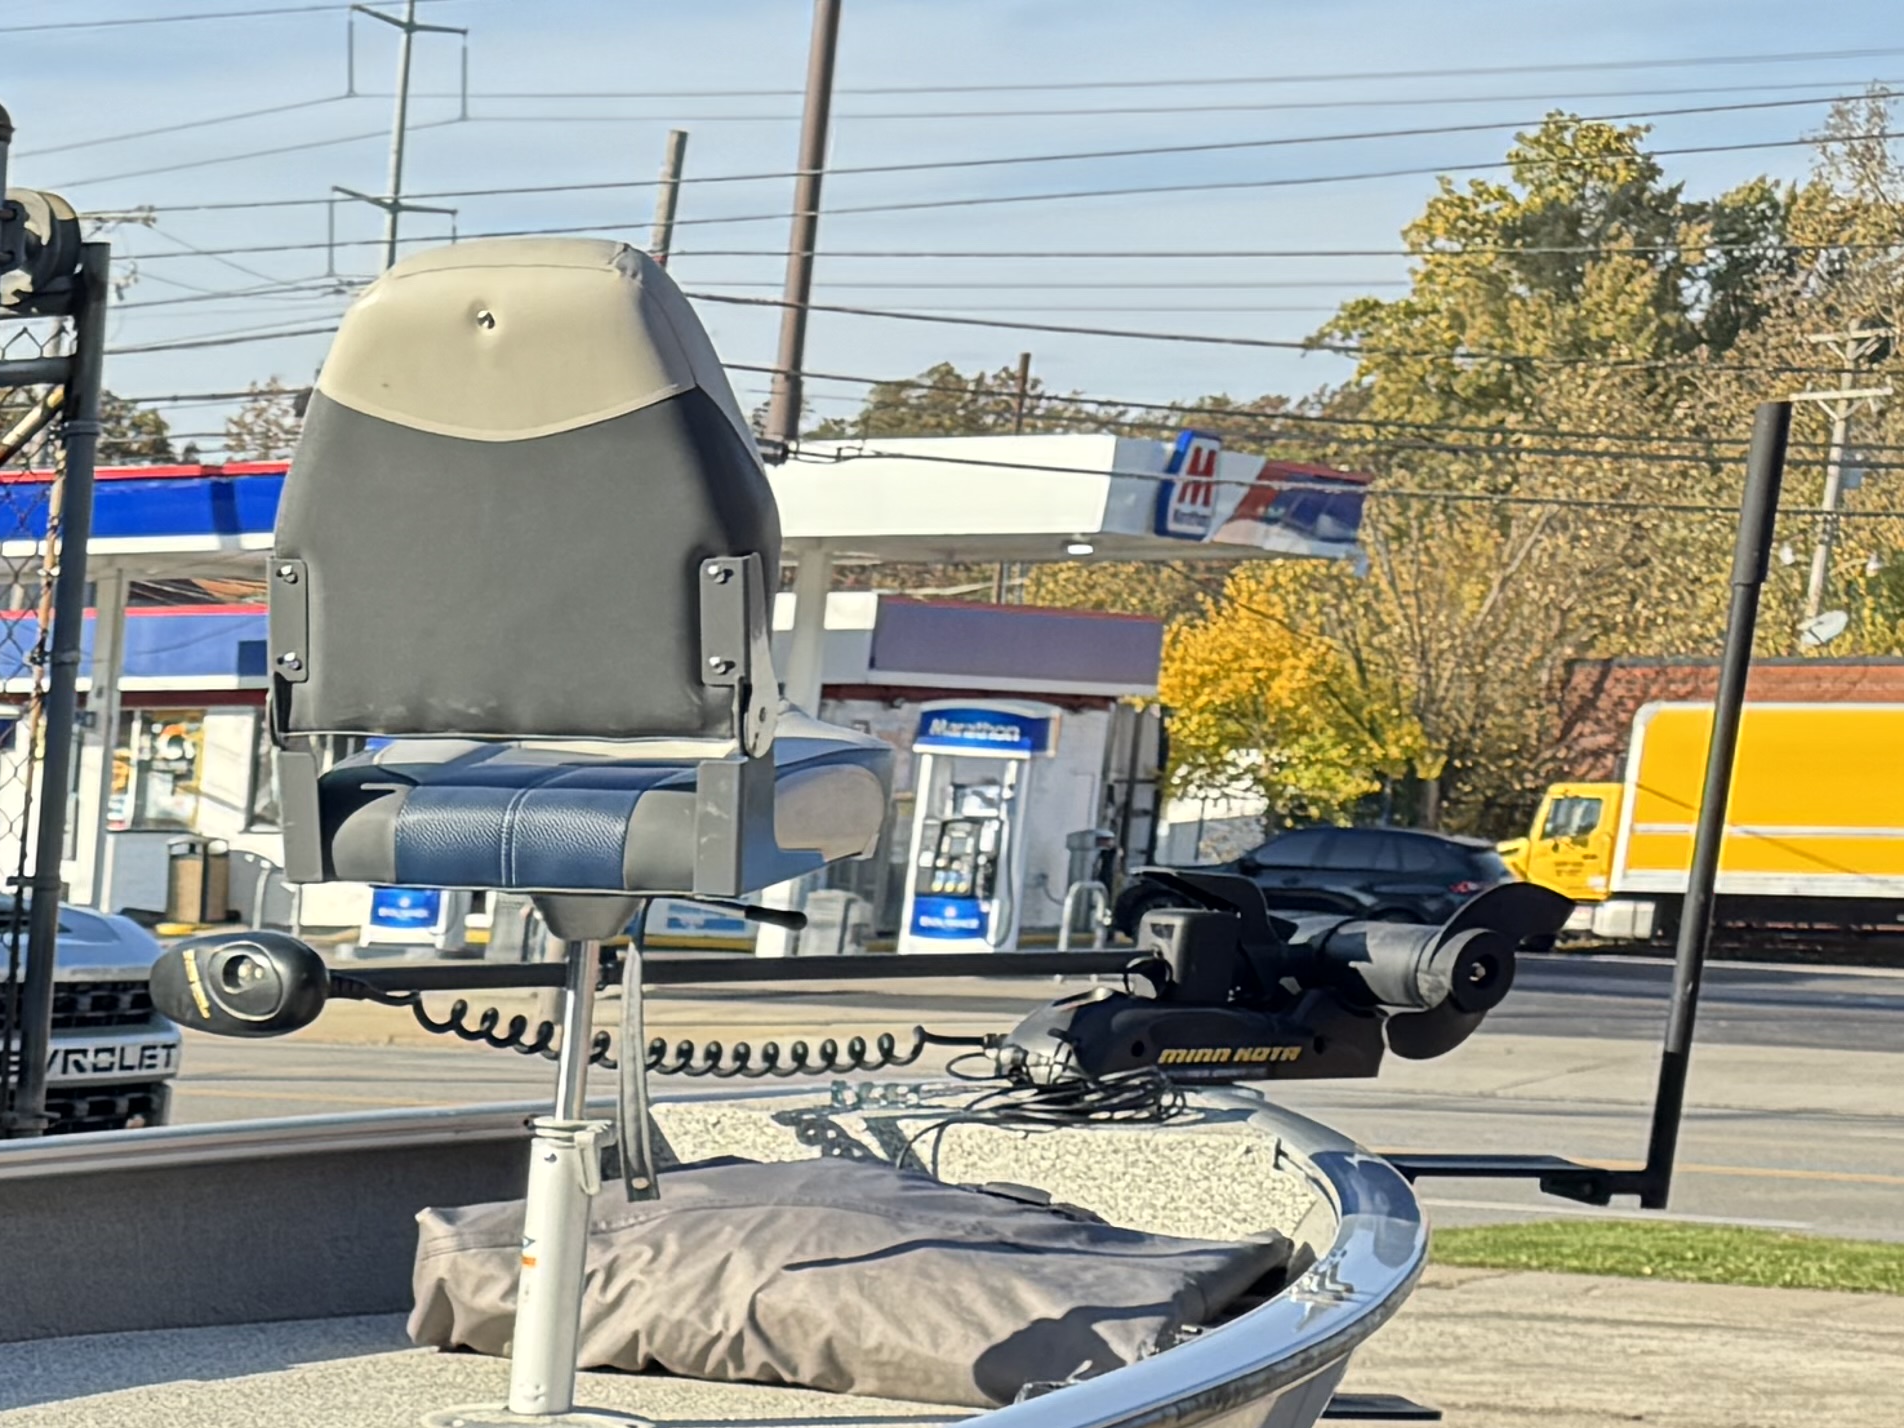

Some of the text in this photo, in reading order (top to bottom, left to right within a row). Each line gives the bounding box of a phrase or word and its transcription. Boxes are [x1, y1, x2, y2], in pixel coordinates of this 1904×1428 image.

[929, 717, 1021, 742] Marathon
[1157, 1045, 1303, 1064] MINN KOTA
